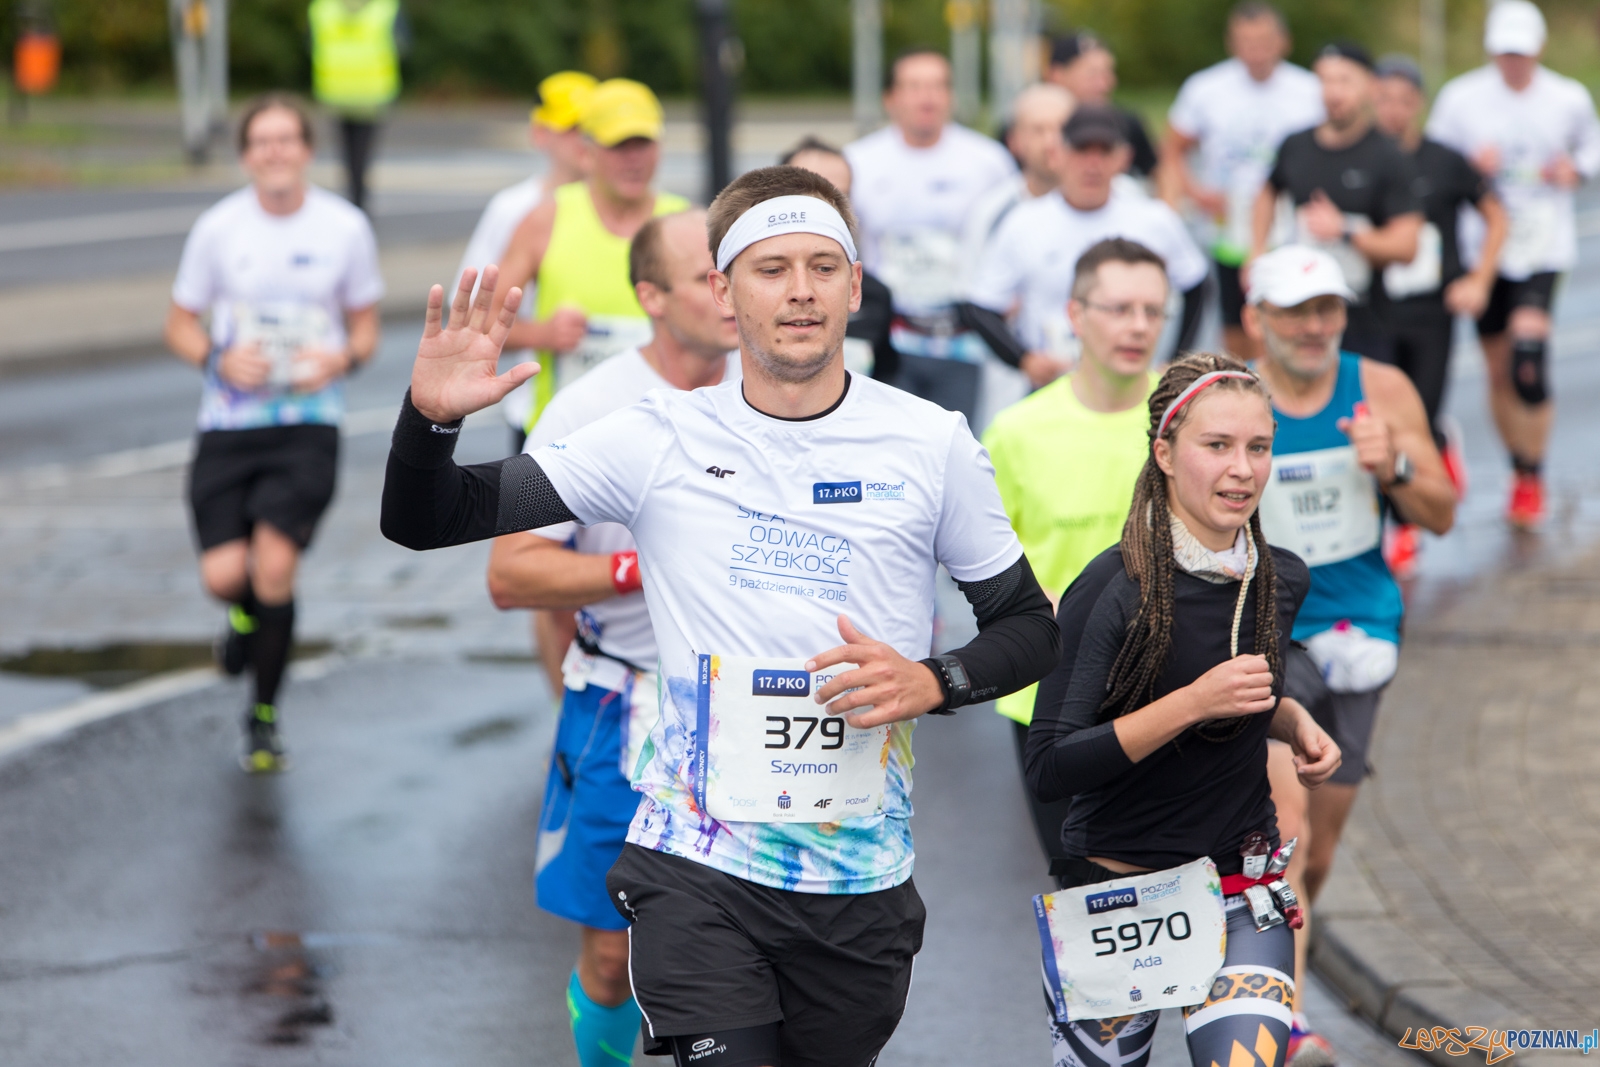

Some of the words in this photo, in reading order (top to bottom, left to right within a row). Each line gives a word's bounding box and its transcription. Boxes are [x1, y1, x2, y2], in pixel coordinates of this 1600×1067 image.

[768, 211, 806, 223] GORE
[866, 490, 905, 498] maraton
[750, 525, 852, 555] ODWAGA
[730, 543, 851, 577] SZYBKOŚĆ
[729, 574, 738, 587] 9
[740, 576, 815, 597] października
[818, 587, 847, 602] 2016
[764, 715, 845, 750] 379
[771, 759, 838, 777] Szymon
[814, 798, 833, 809] 4F
[1142, 886, 1181, 902] maraton
[1091, 911, 1192, 957] 5970
[1132, 955, 1163, 971] Ada
